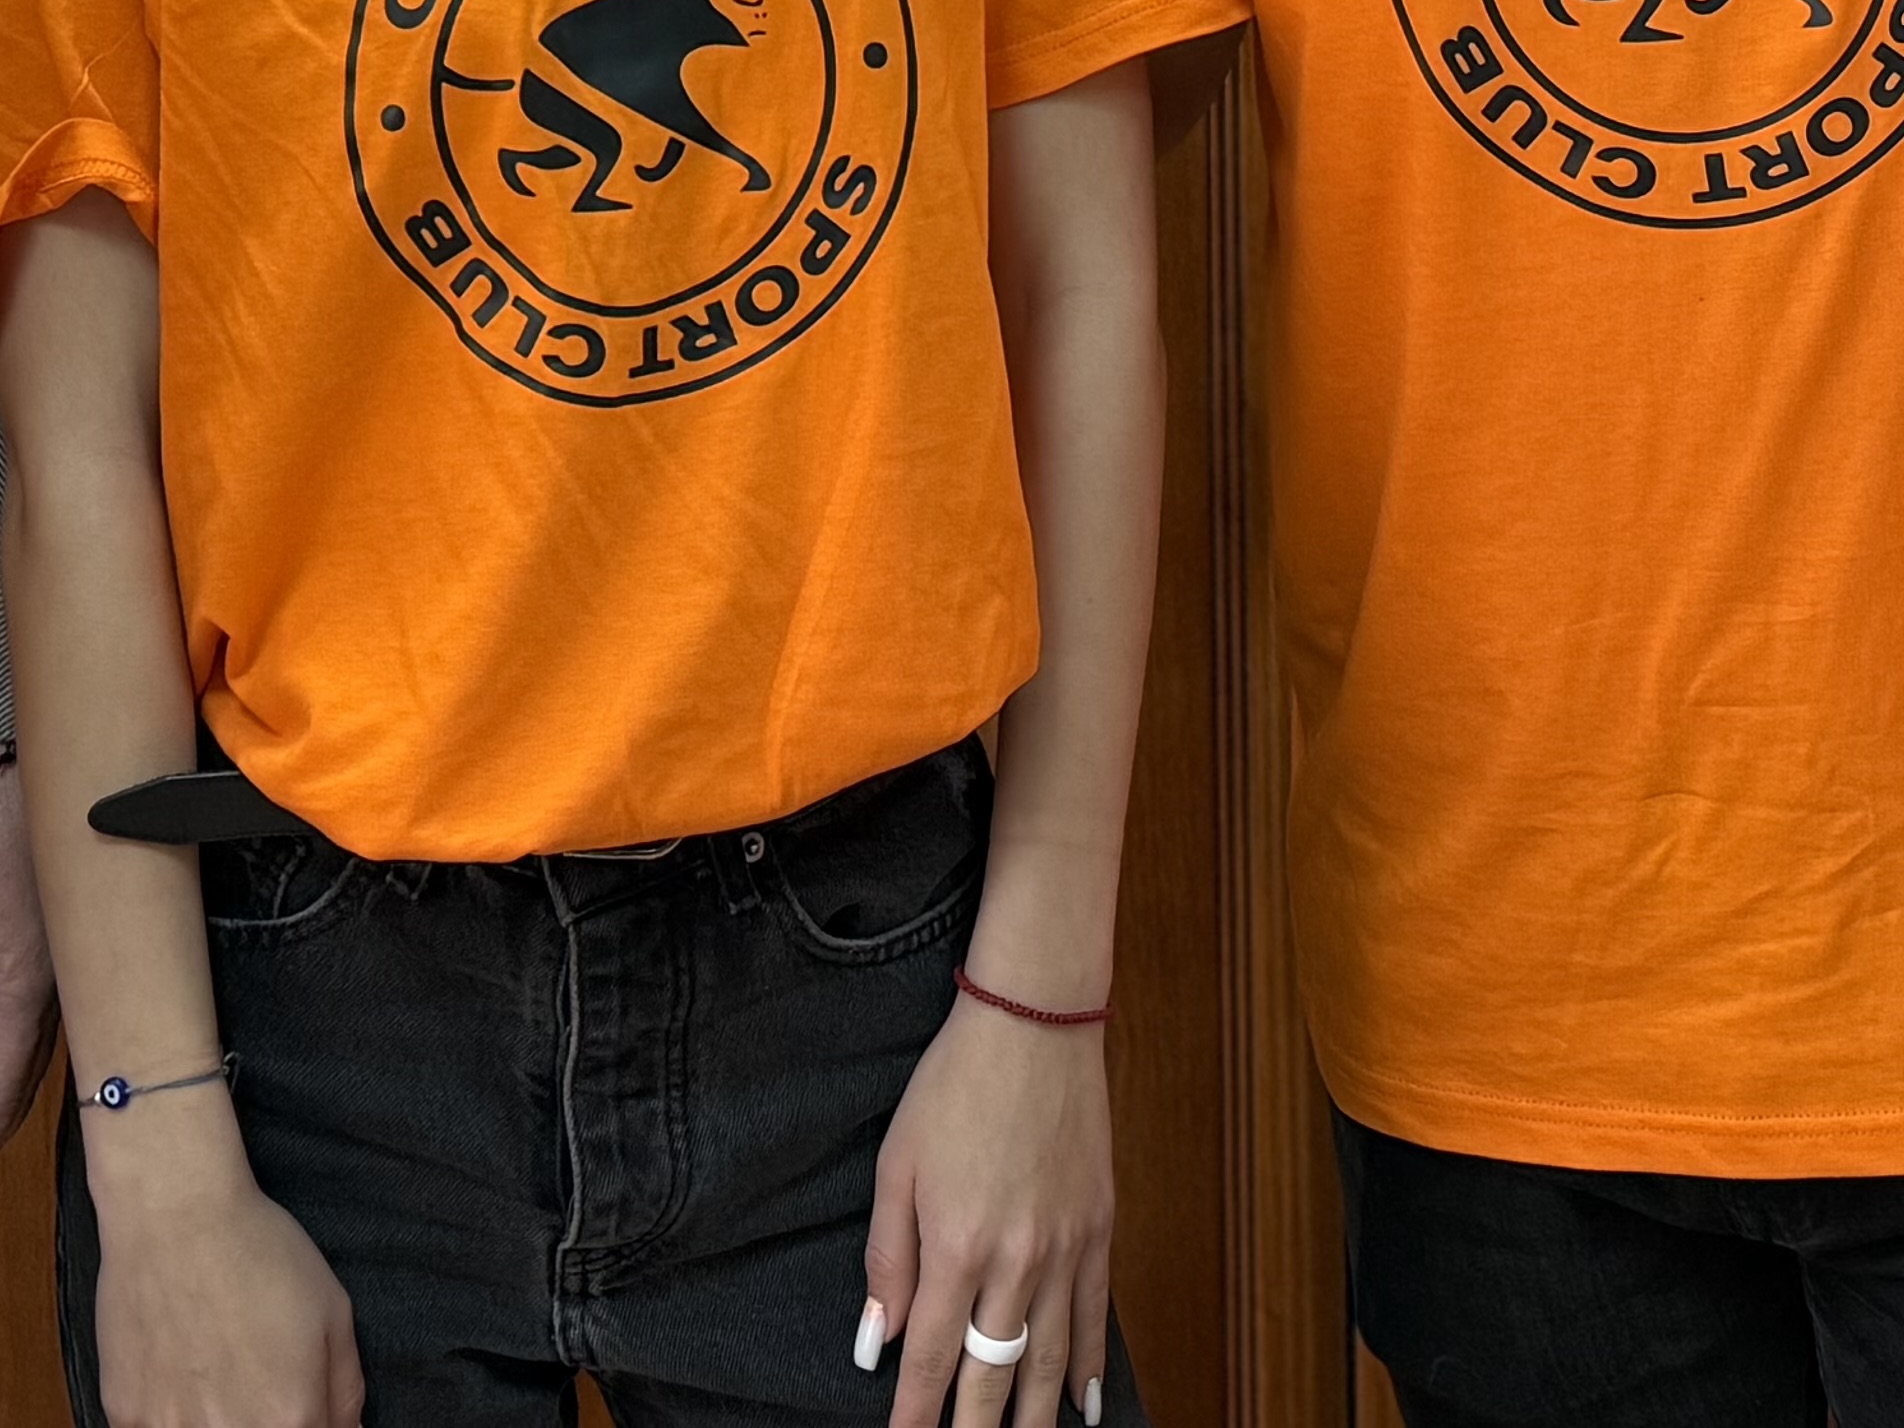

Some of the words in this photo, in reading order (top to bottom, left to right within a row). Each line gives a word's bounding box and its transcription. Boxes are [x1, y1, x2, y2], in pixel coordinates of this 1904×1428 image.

[1439, 23, 1658, 200] CLUB
[403, 198, 608, 379] CLUB
[627, 153, 878, 380] SPORT
